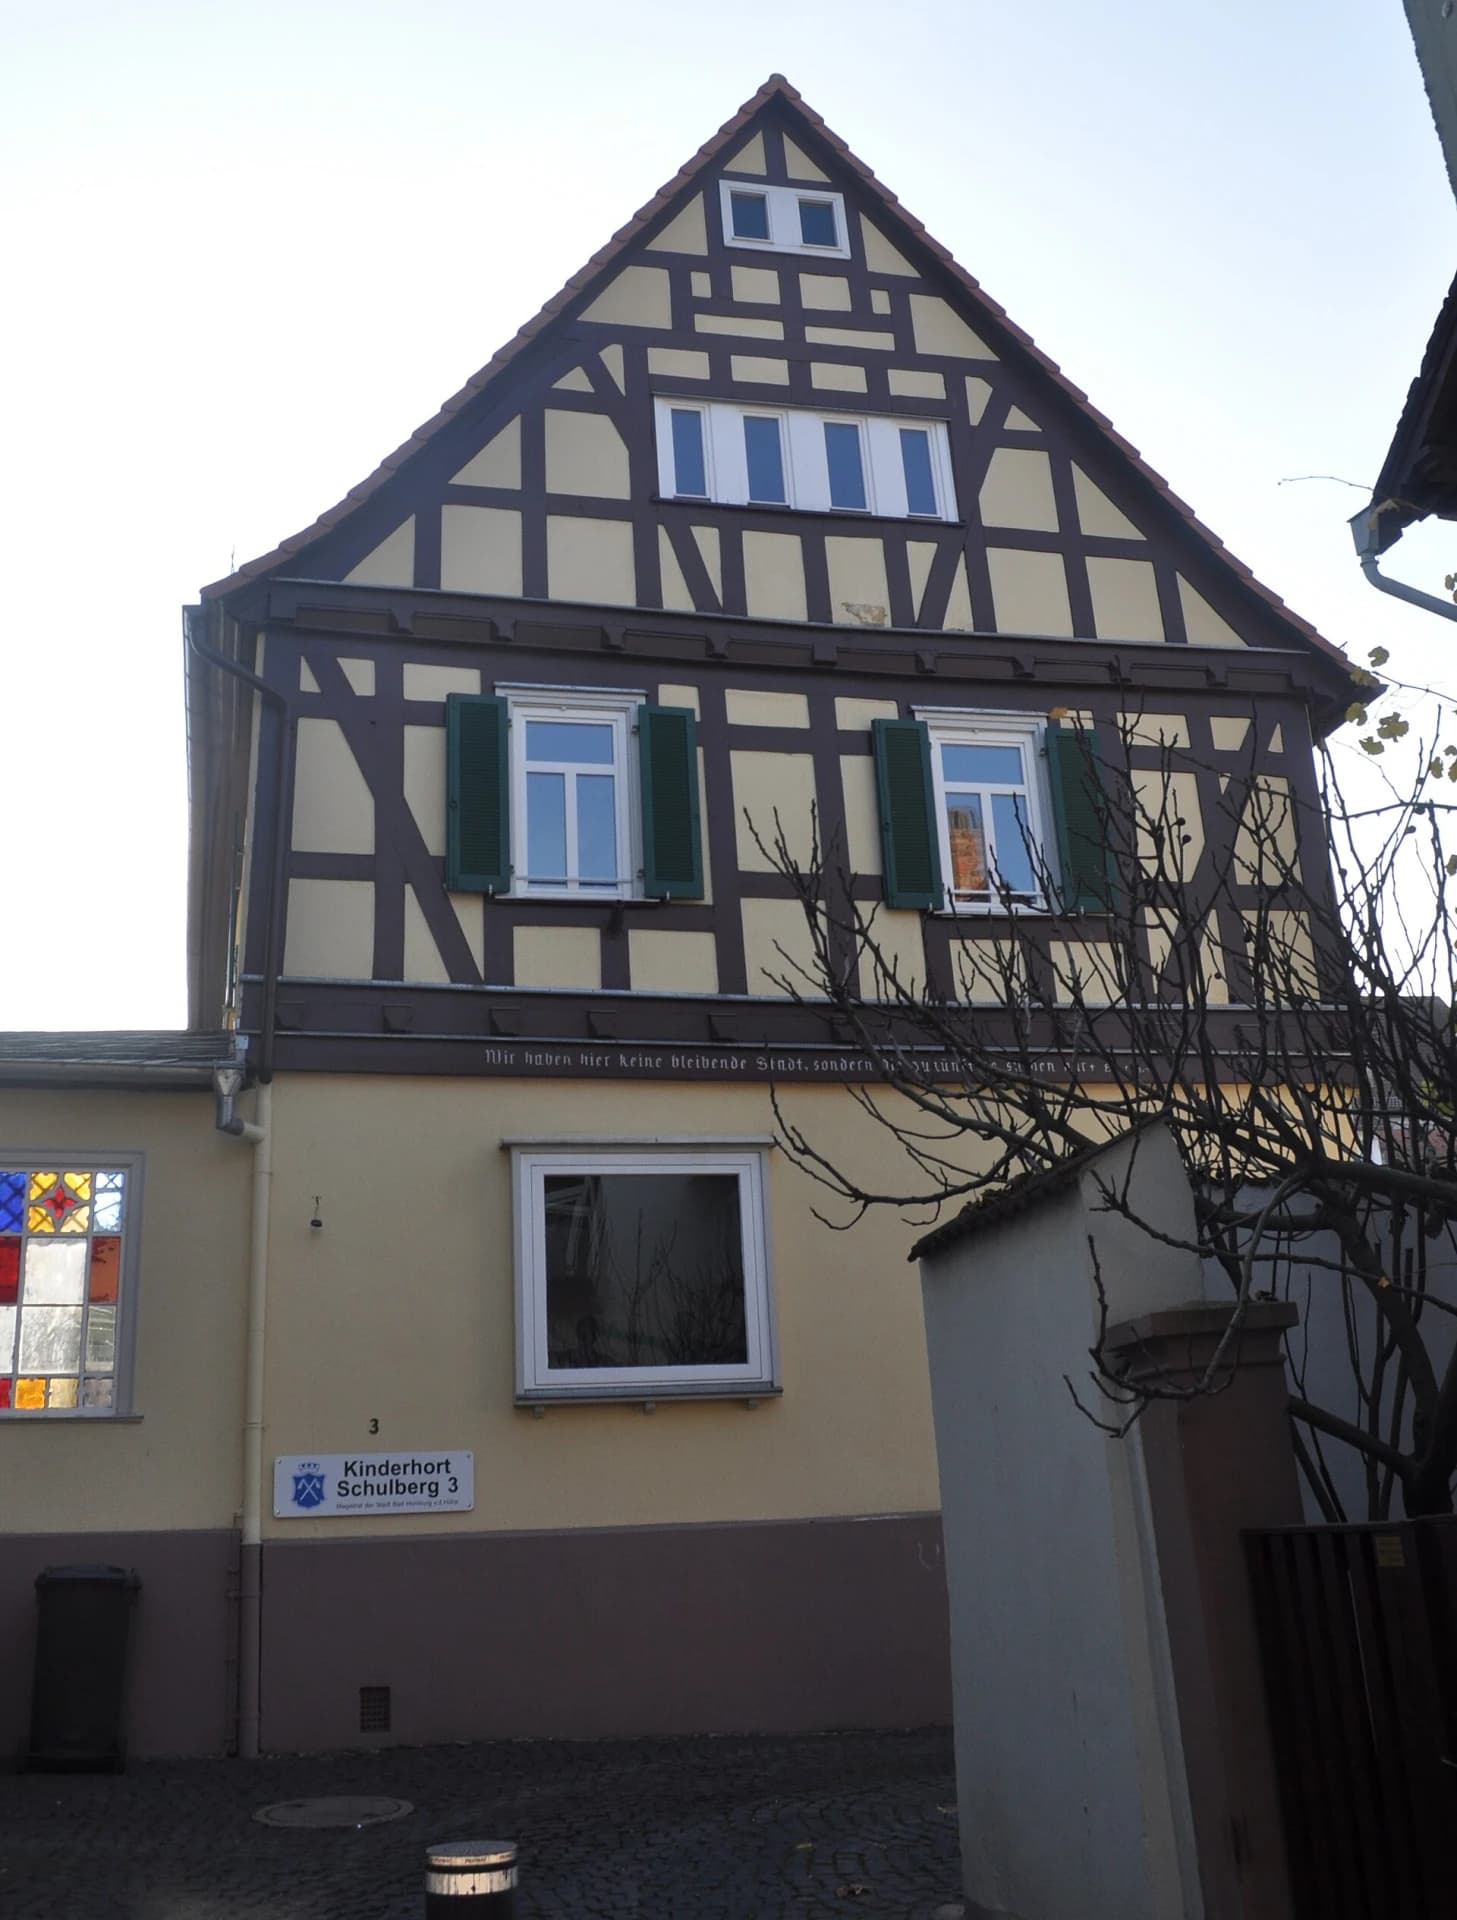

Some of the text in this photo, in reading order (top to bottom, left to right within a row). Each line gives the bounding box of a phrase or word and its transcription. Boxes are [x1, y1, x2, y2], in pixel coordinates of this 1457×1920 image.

[485, 1049, 515, 1065] Wir
[525, 1051, 573, 1066] haben
[580, 1052, 610, 1067] hier
[619, 1053, 663, 1068] keine
[671, 1054, 747, 1069] bleibende
[813, 1057, 874, 1071] sondern
[368, 1418, 380, 1435] 3
[344, 1458, 451, 1478] Kinderhort
[337, 1476, 459, 1498] Schulberg 3
